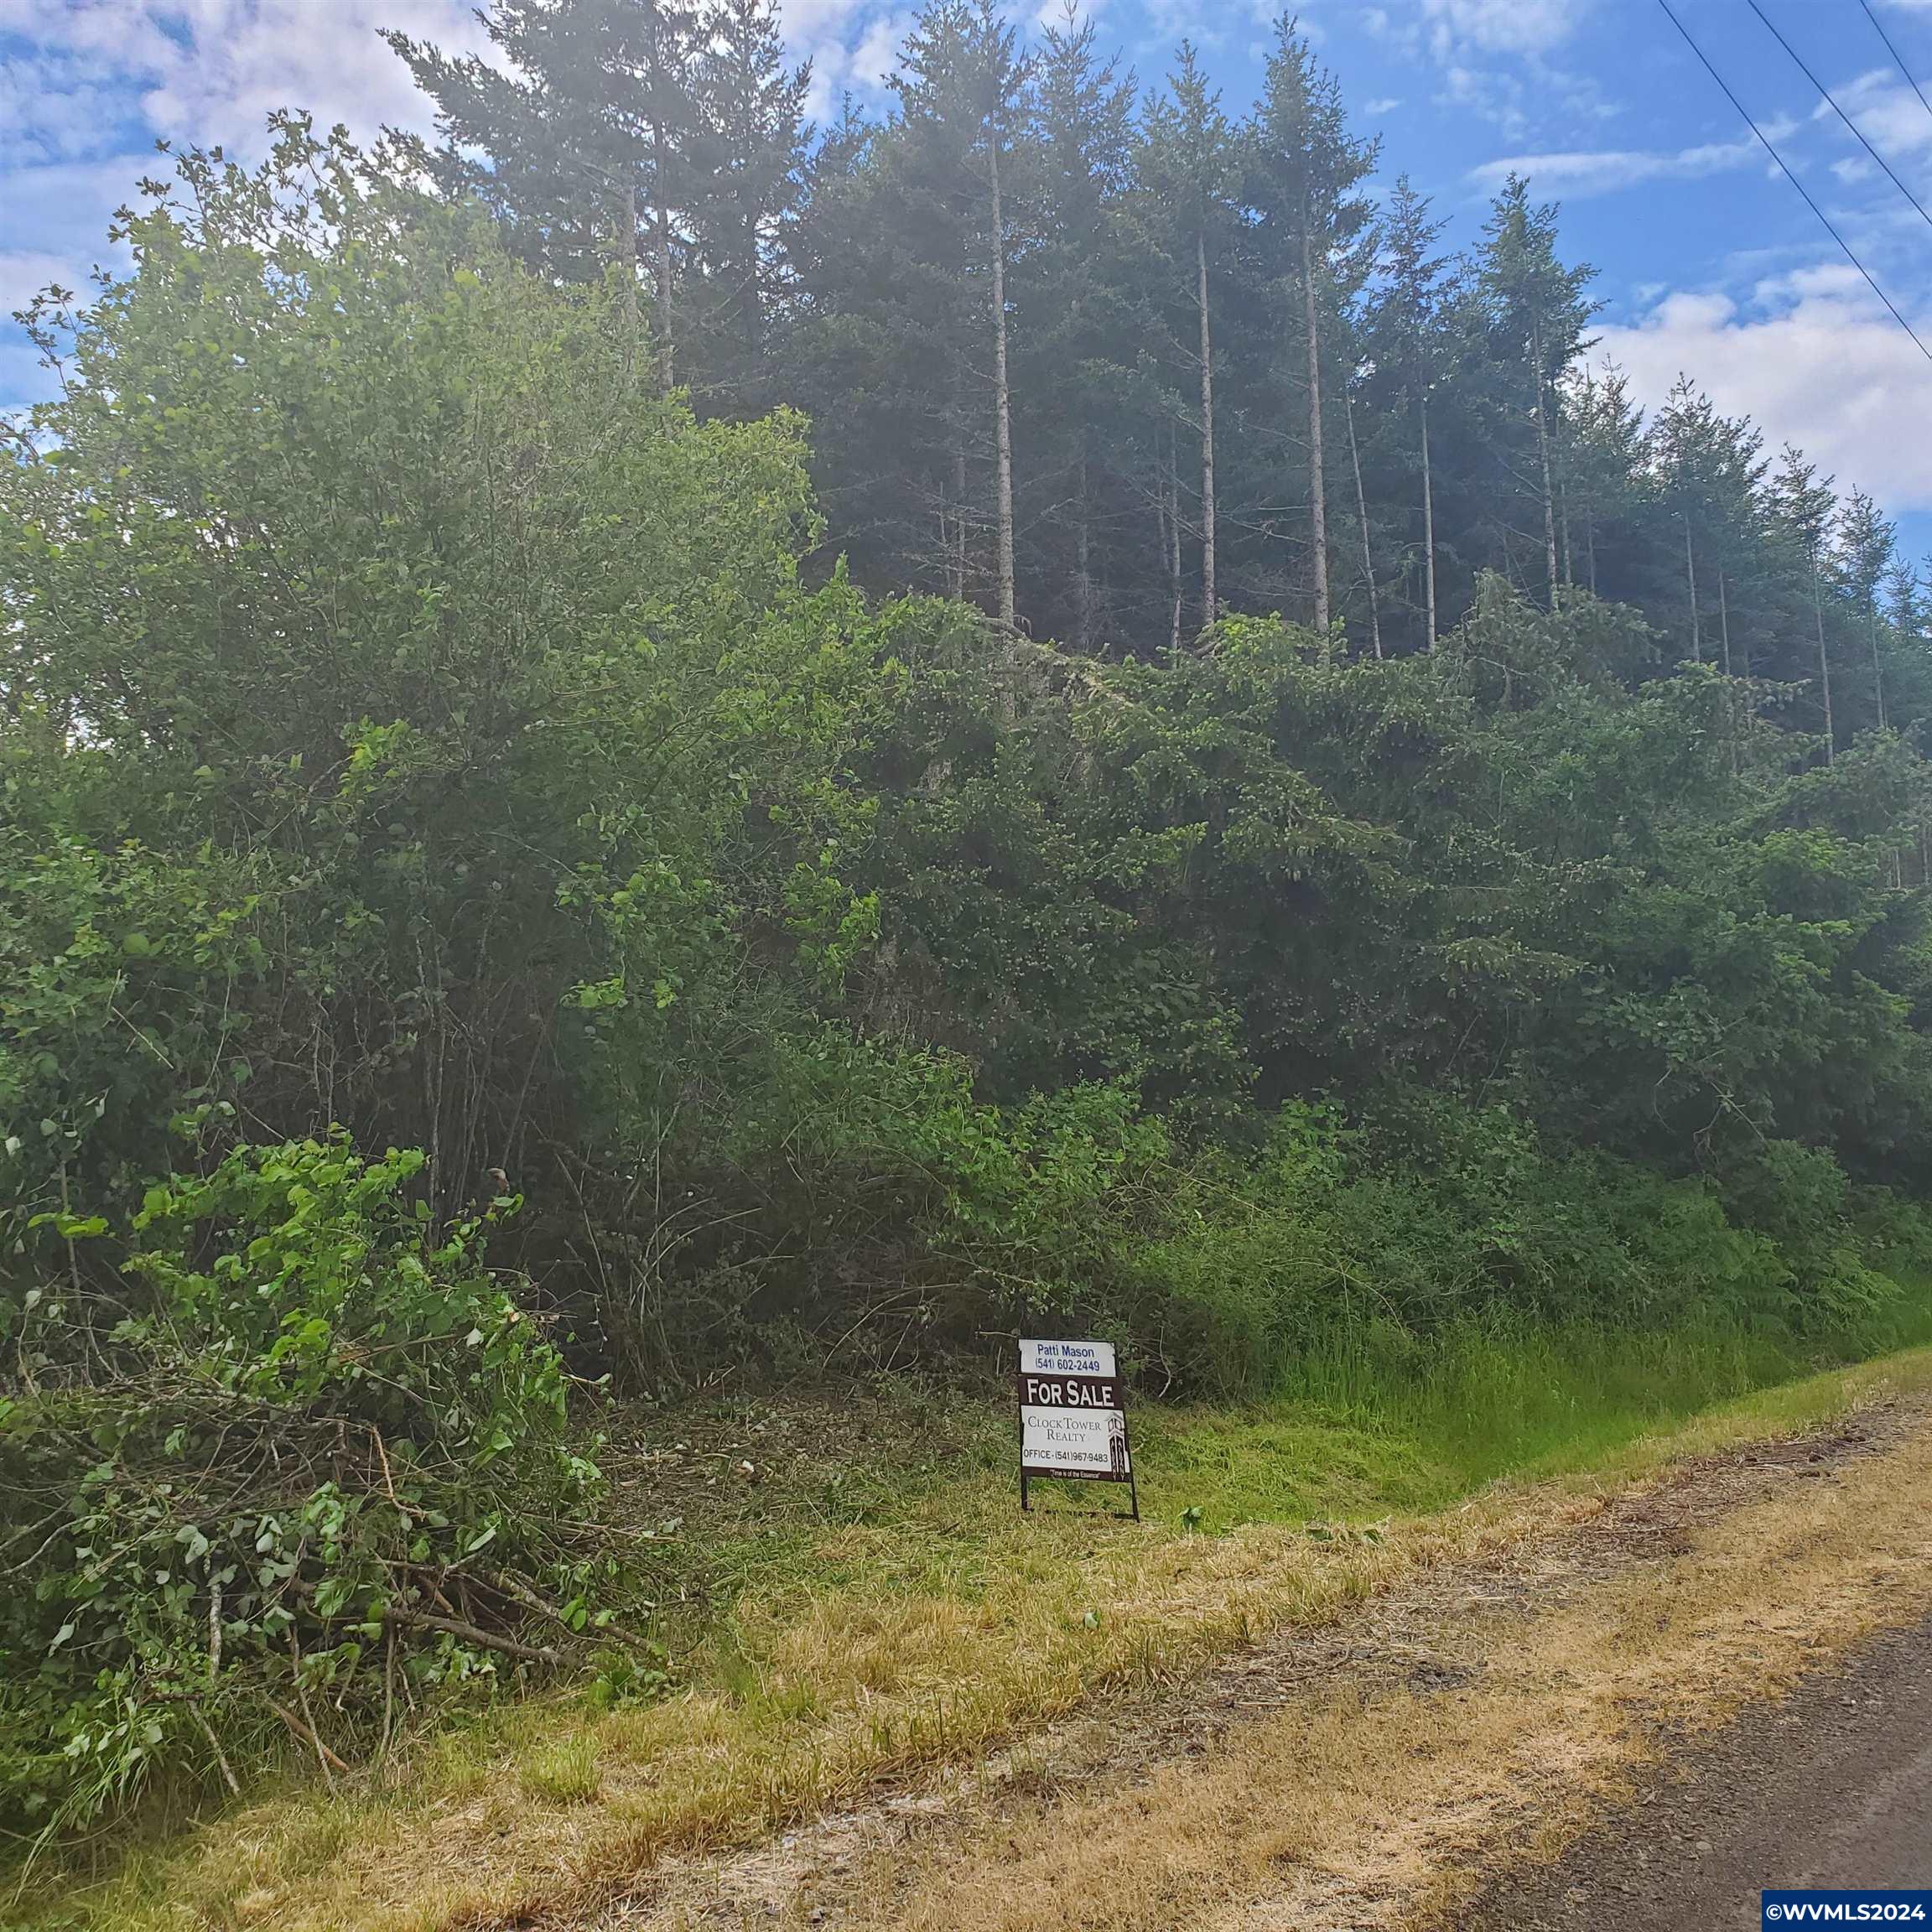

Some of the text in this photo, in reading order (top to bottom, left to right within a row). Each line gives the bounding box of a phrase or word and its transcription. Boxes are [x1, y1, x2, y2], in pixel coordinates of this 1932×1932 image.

[1037, 1344, 1094, 1358] Patti Mason
[1036, 1358, 1100, 1371] (541) 602-2449
[1026, 1379, 1114, 1407] FOR SALE
[1047, 1429, 1086, 1442] REALTY
